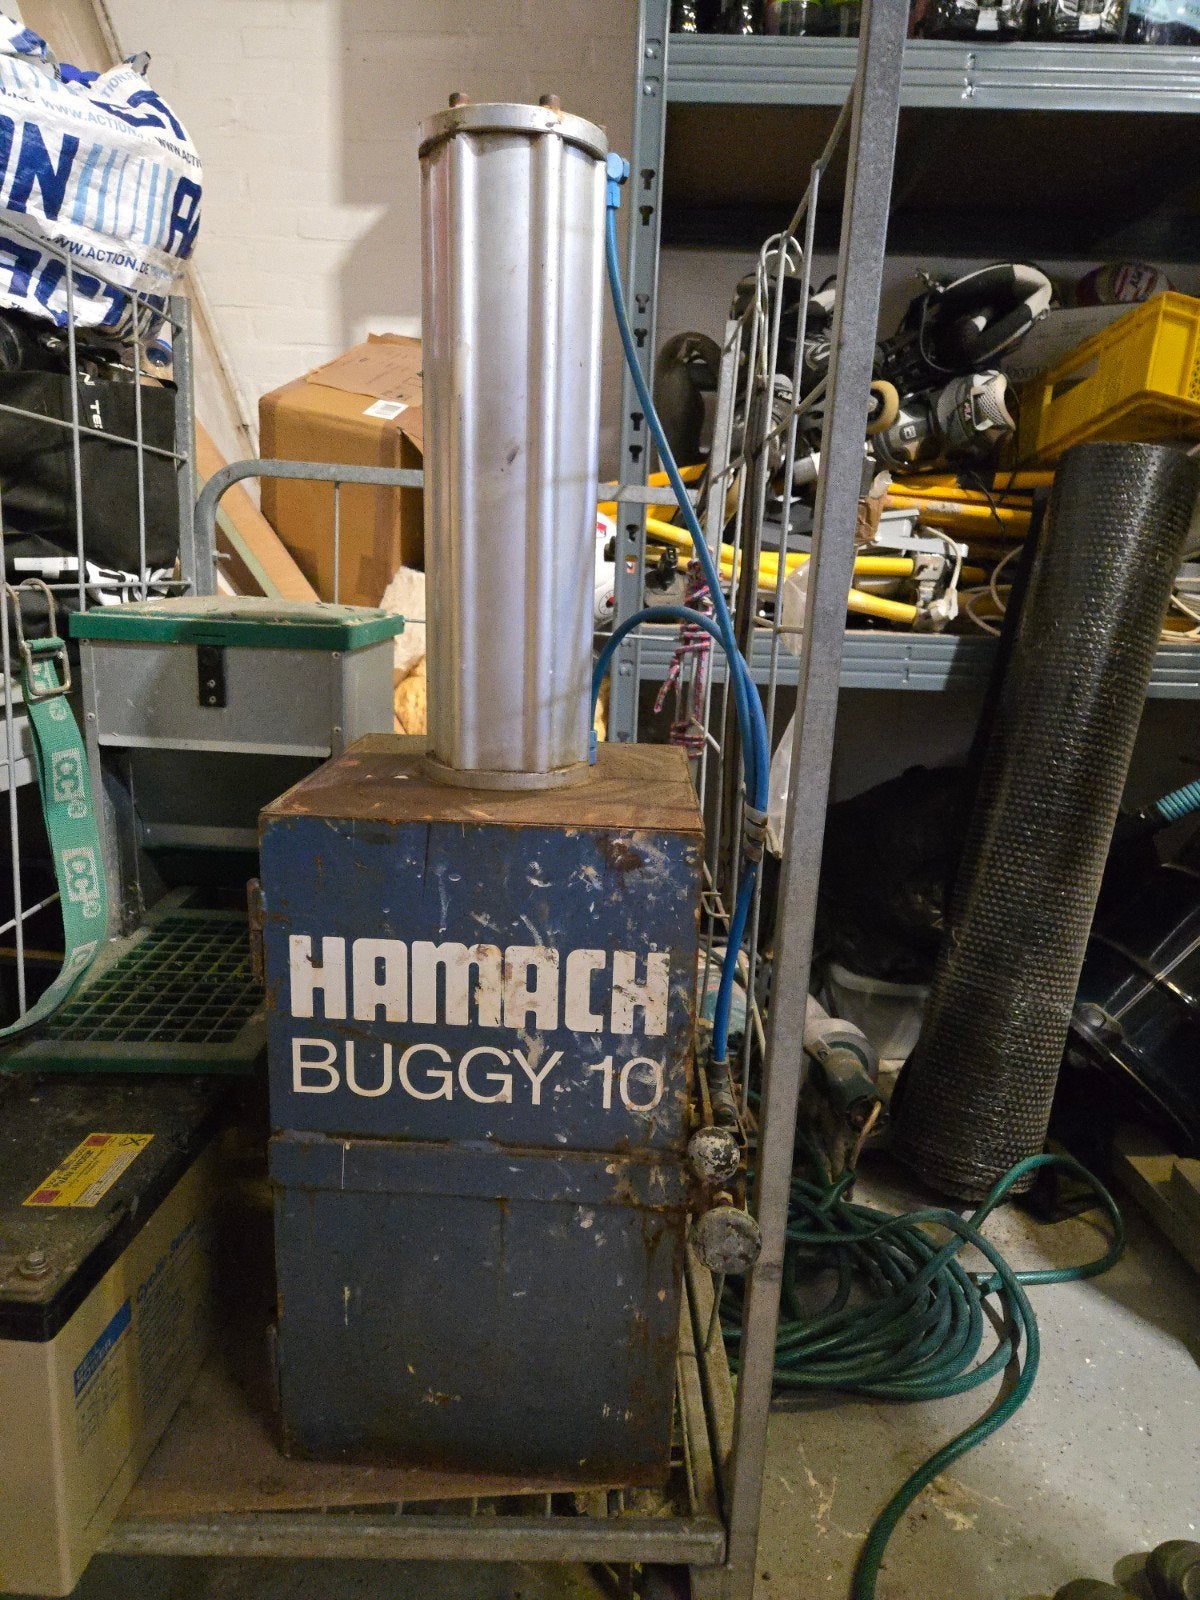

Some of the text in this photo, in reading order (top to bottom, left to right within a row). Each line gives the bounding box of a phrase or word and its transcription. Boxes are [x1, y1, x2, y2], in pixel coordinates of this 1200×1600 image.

[288, 934, 671, 1037] HAMACH
[292, 1037, 664, 1112] BUGGY 10
